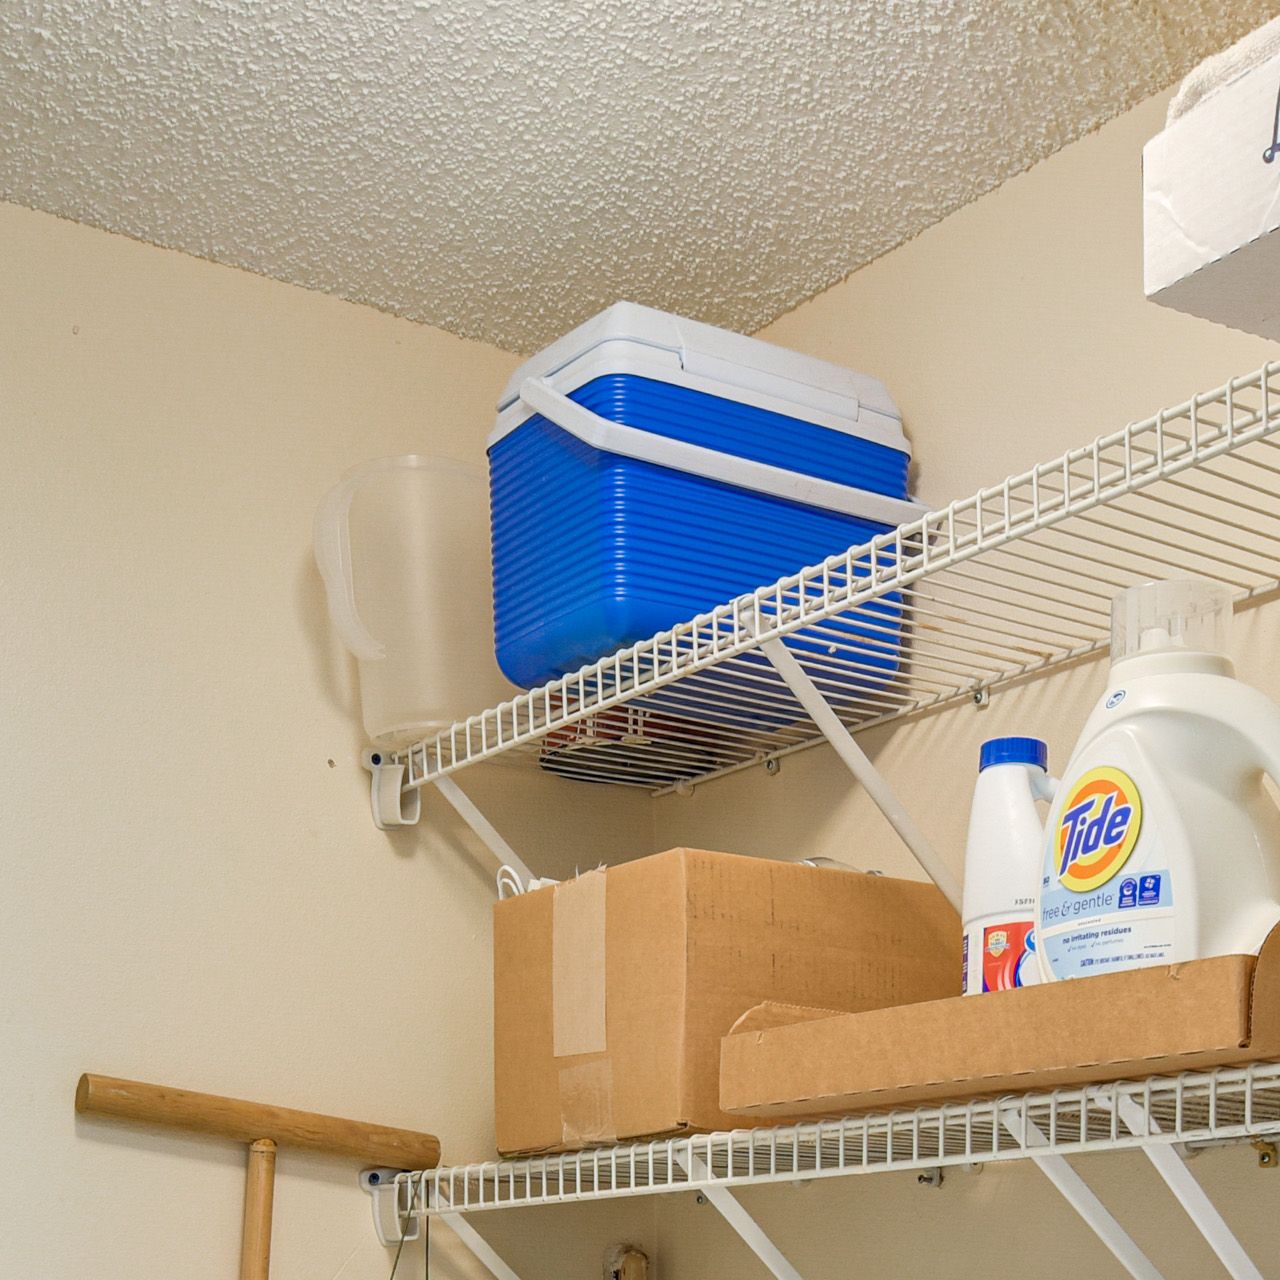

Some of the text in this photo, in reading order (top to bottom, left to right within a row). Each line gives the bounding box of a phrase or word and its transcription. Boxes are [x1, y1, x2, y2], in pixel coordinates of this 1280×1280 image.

[1059, 792, 1132, 878] Tide
[1042, 893, 1113, 922] free & gentle
[1062, 925, 1132, 945] no irritating residues
